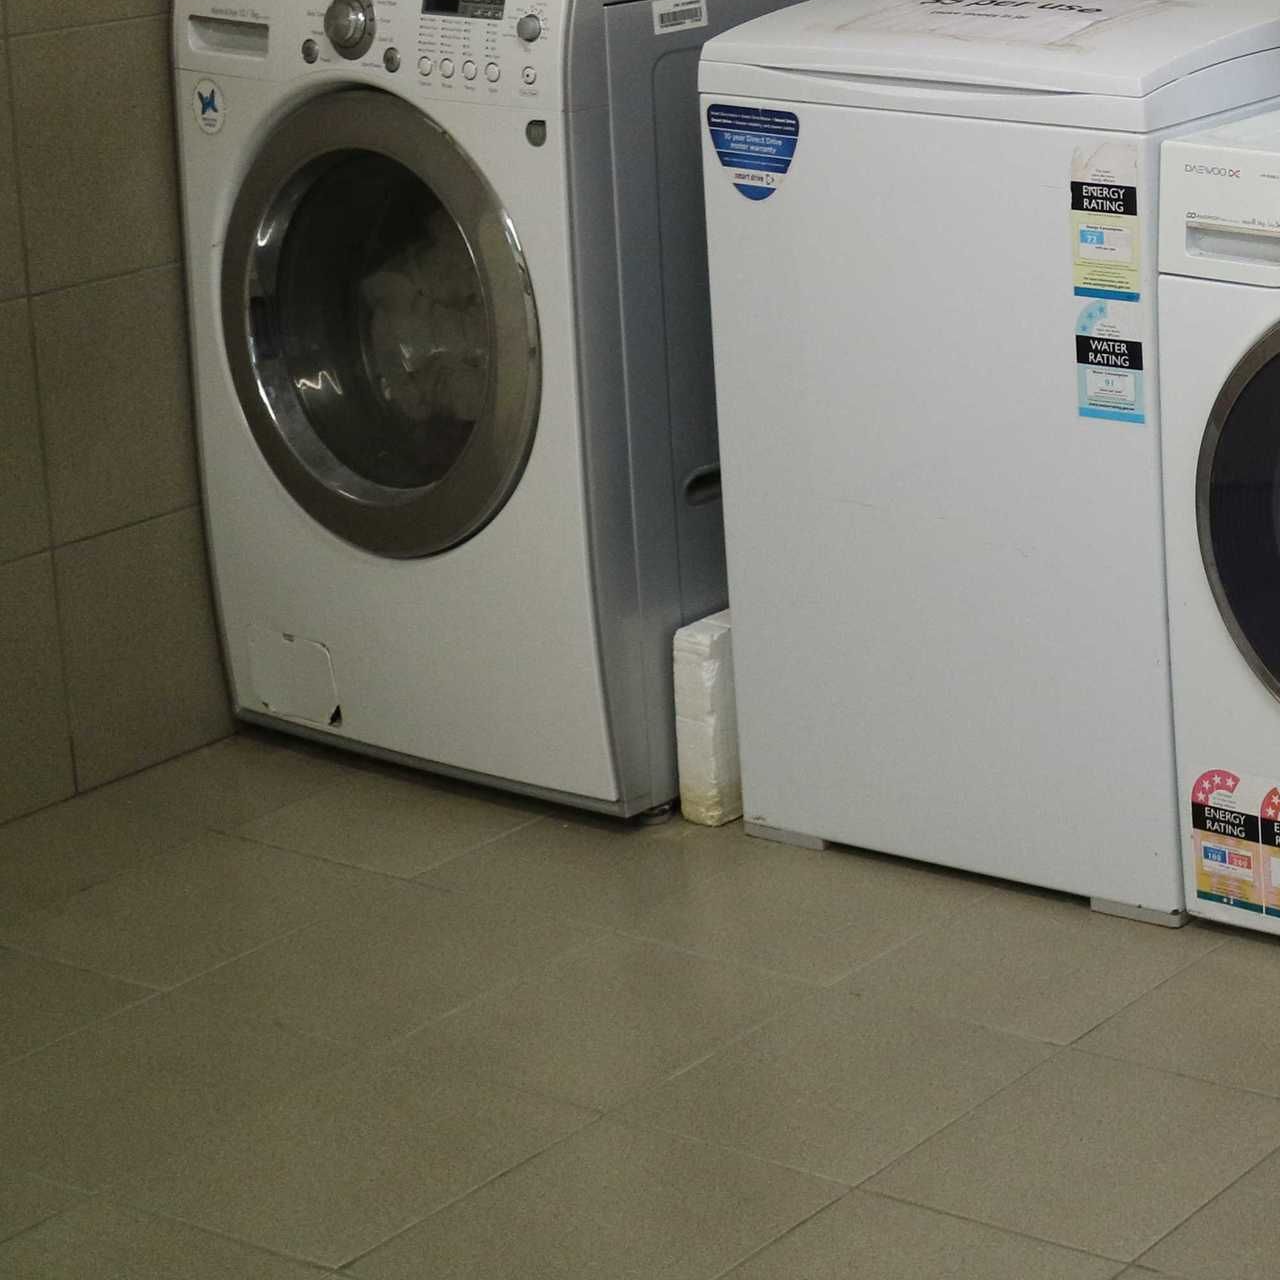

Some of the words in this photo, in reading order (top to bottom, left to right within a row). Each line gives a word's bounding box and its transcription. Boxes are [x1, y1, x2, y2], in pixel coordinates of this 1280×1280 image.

[1082, 185, 1125, 200] ENERGY
[1083, 198, 1124, 213] RATING
[1089, 338, 1128, 354] WATER
[1088, 353, 1130, 367] RATING
[1204, 807, 1246, 825] ENERGY
[1206, 819, 1246, 838] RATING
